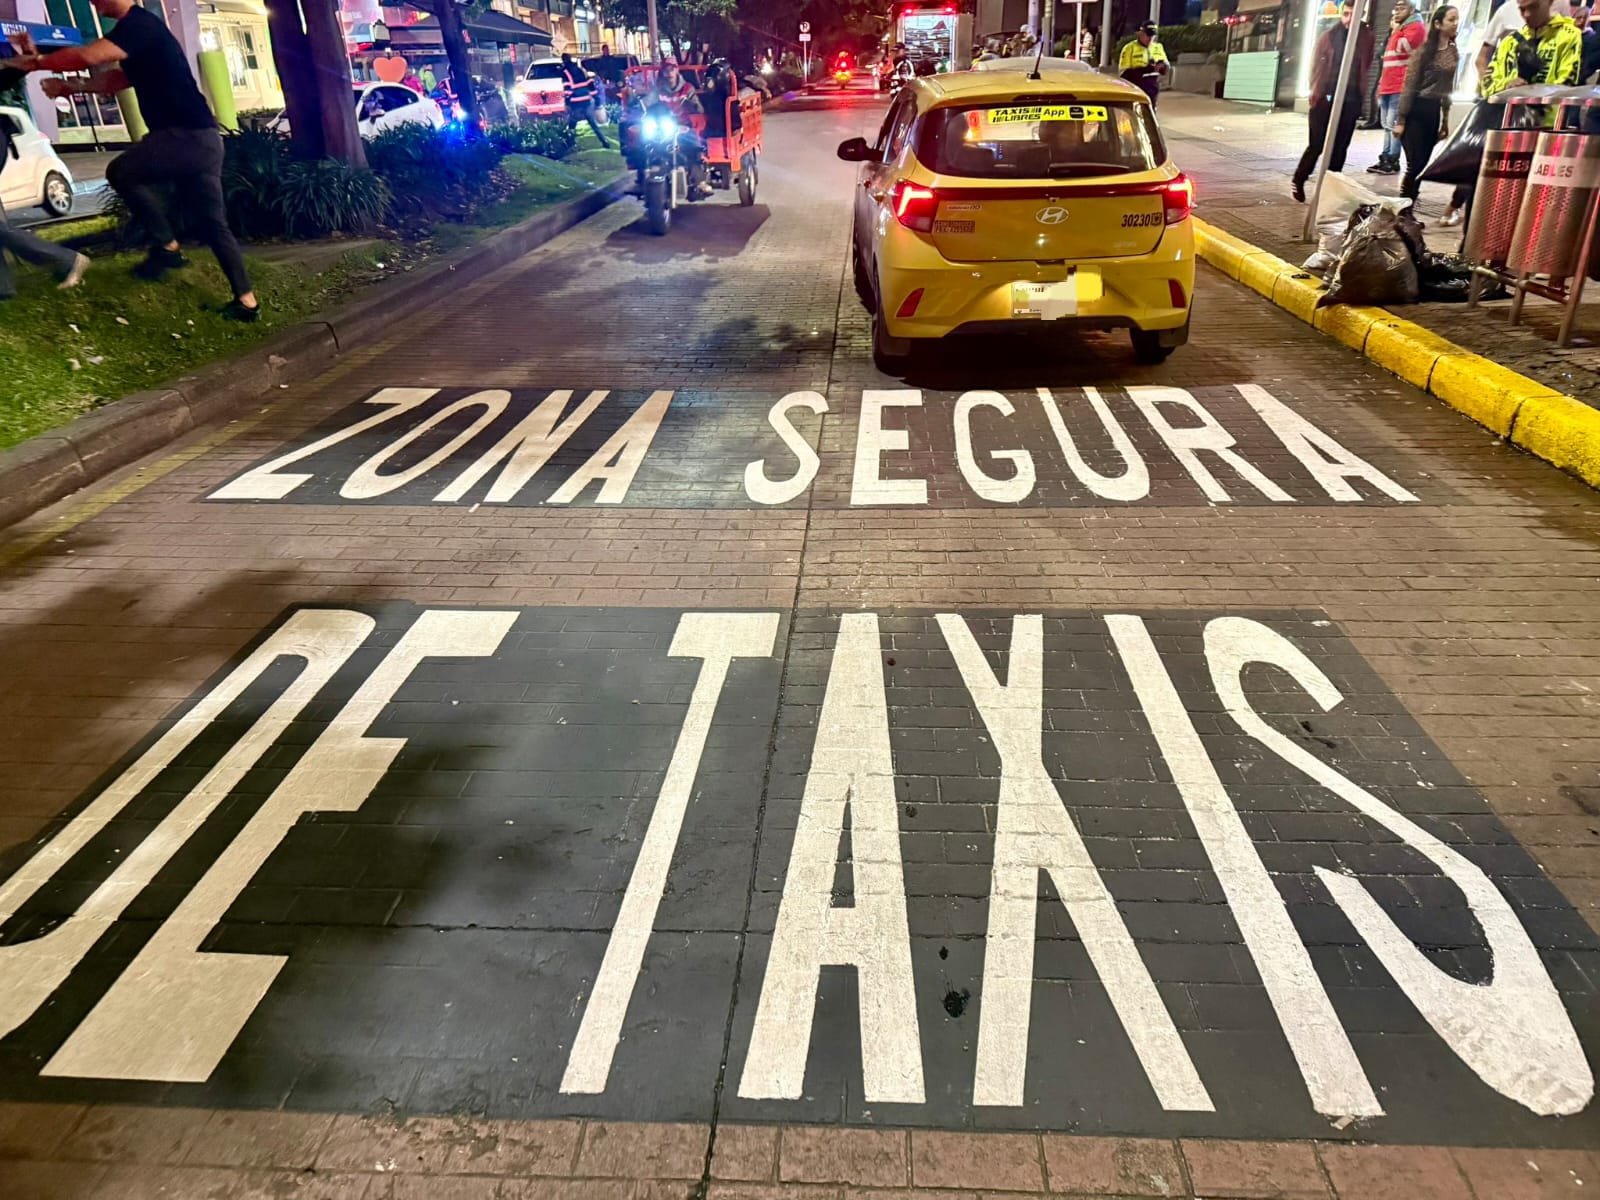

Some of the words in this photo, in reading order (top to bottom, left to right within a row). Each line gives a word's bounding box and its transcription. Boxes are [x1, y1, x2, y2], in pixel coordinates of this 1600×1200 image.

[995, 107, 1030, 117] TAXIS
[1044, 108, 1065, 117] App
[1533, 163, 1574, 178] ABLES
[1121, 213, 1151, 228] 30230
[207, 387, 674, 504] ZONA
[743, 384, 1420, 505] SEGURA
[0, 609, 521, 1082] DE
[560, 612, 1594, 1117] TAXIS
